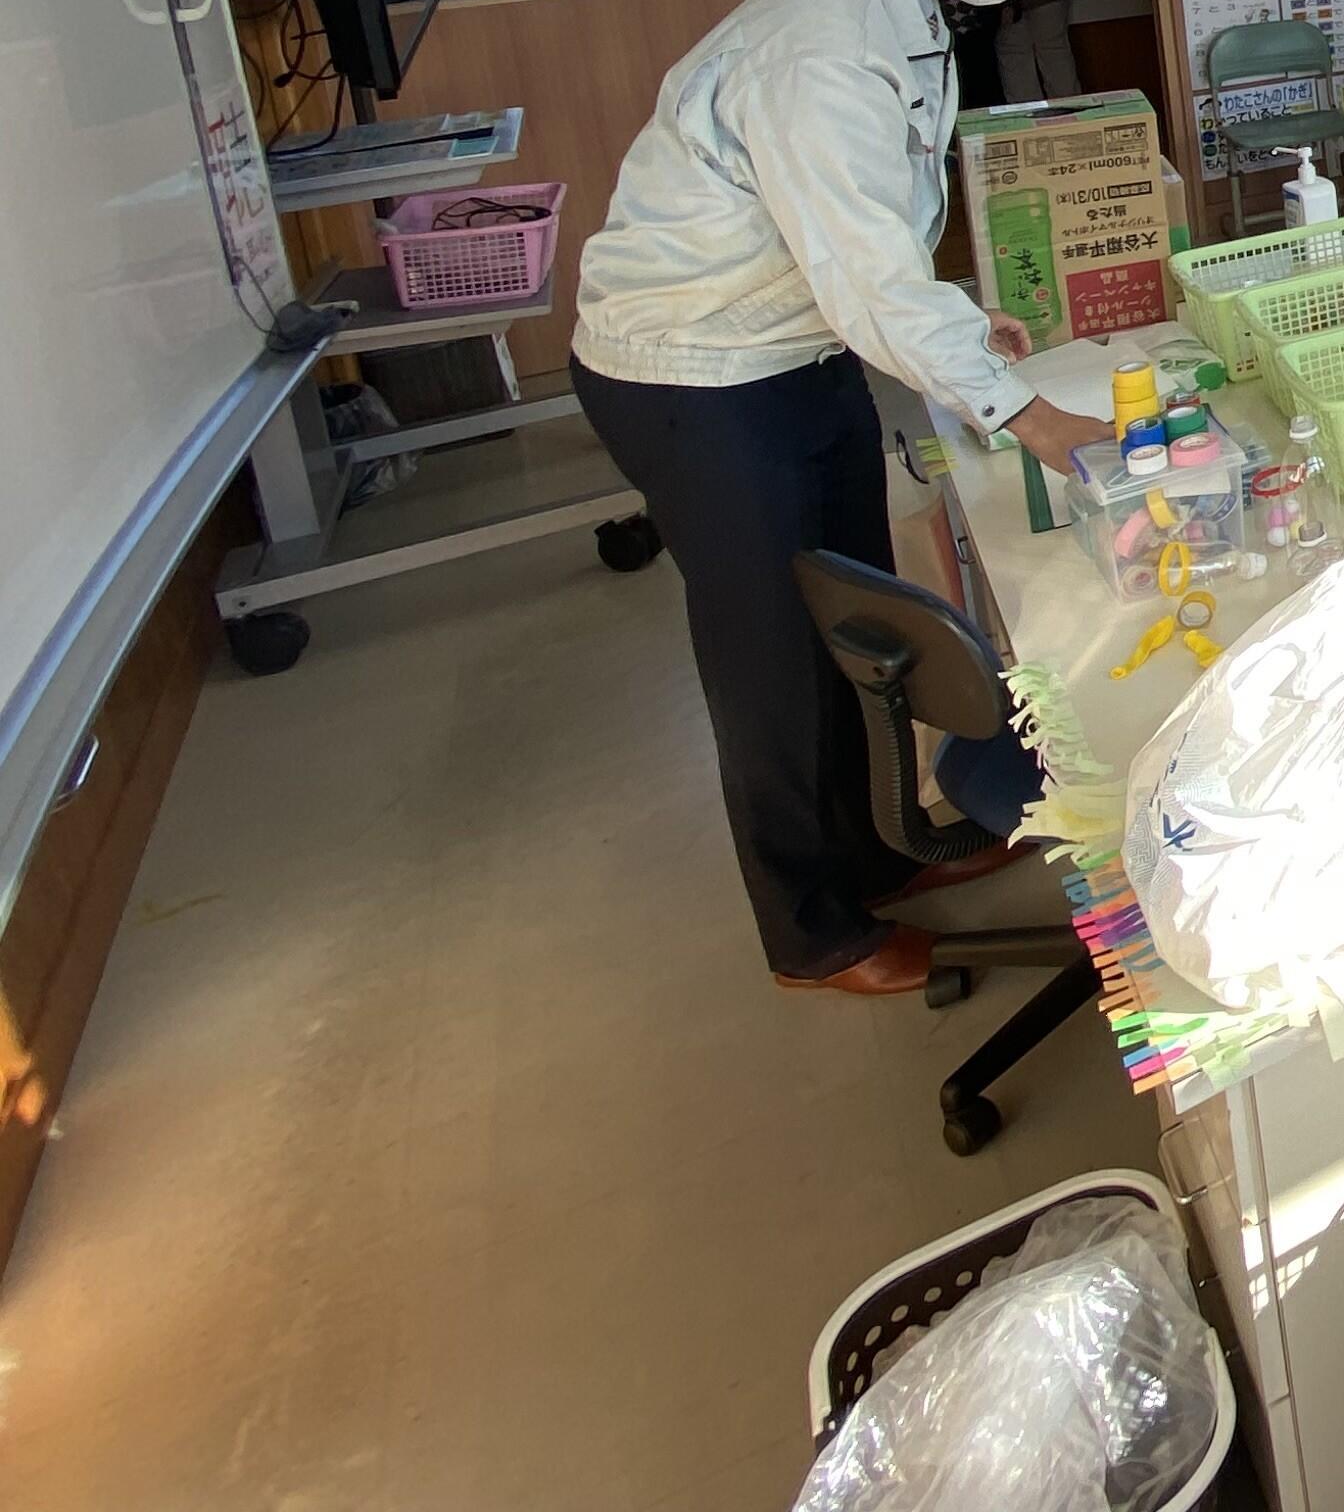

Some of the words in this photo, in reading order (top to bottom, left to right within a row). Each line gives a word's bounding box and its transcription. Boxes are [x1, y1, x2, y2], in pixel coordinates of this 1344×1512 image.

[1086, 203, 1128, 222] 当たる
[1062, 215, 1155, 237] オリジナルマイボトル
[1061, 230, 1159, 260] 大谷翔平選手
[1075, 279, 1157, 303] キャンペーン
[1084, 294, 1152, 317] シール付き
[1078, 308, 1160, 331] 大谷翔平選手
